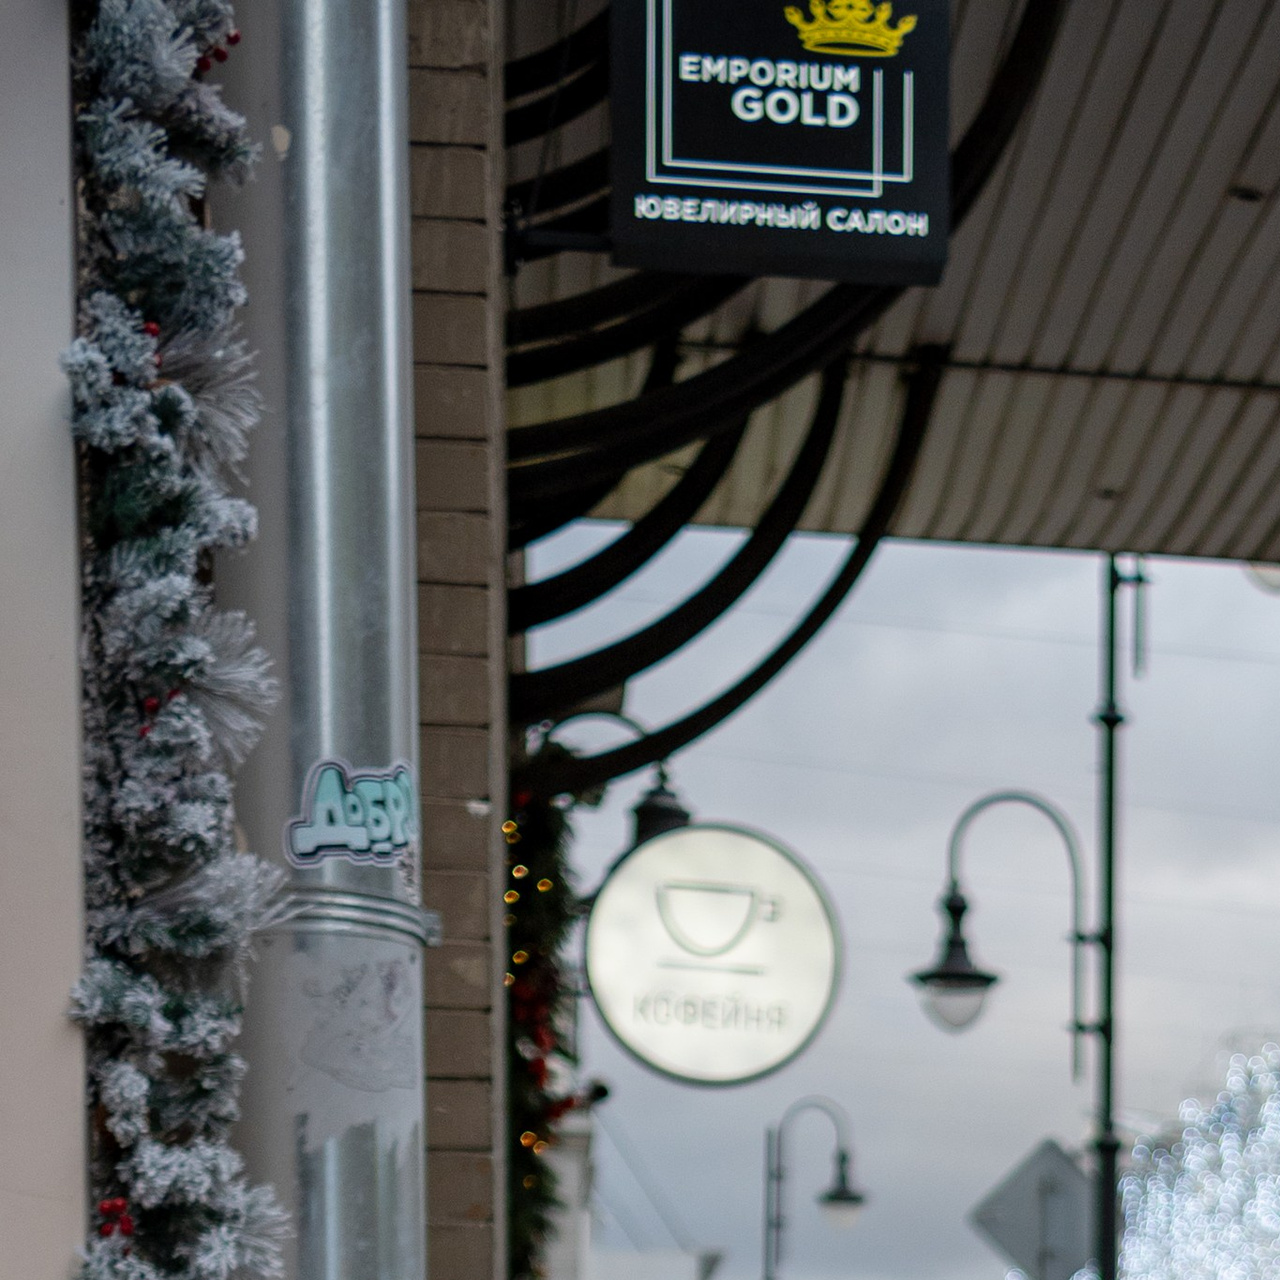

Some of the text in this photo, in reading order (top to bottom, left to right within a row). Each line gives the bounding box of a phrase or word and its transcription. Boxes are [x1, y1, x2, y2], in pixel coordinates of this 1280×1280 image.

[679, 53, 860, 93] EMPORIUM
[731, 86, 860, 128] GOLD
[634, 194, 929, 237] ЮВЕЛИРНЫЙ САЛОН
[632, 990, 790, 1033] КОФЕЙНЯ
